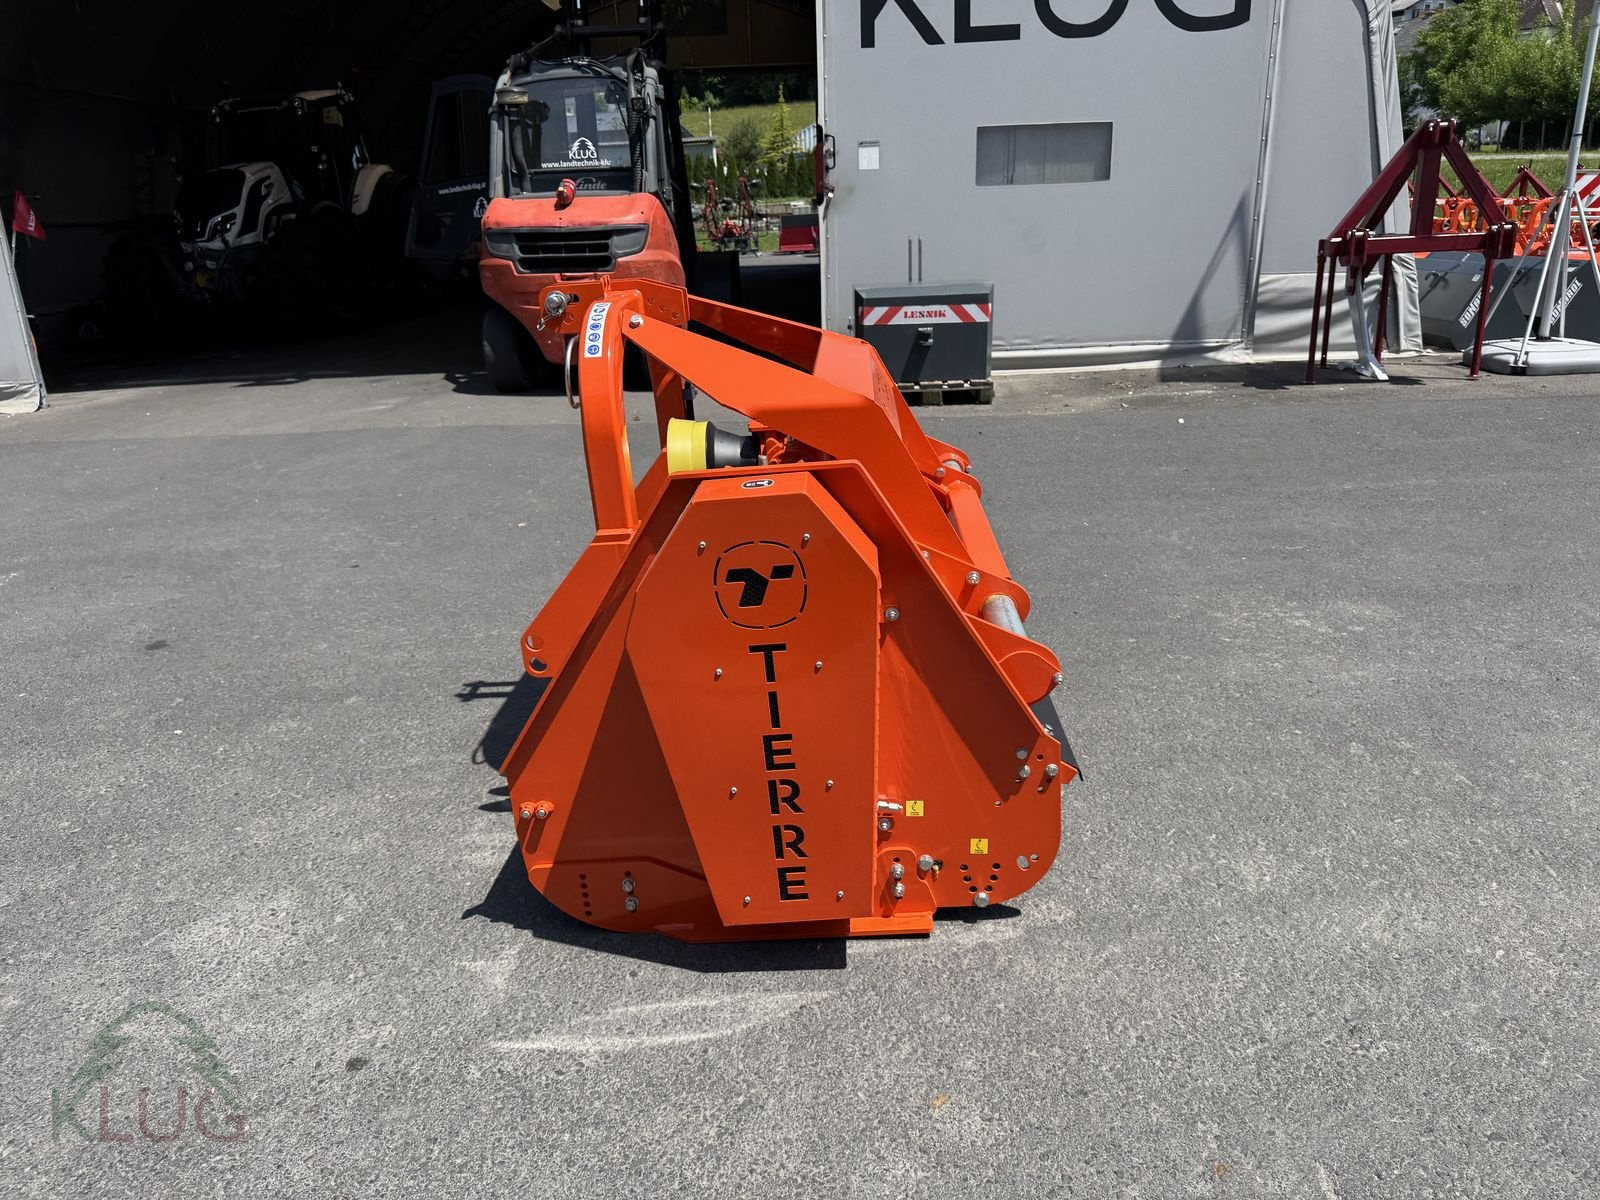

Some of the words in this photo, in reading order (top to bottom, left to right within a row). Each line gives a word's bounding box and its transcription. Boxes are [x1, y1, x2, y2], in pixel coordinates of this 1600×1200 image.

[568, 150, 597, 159] KLUG
[903, 310, 947, 319] LESNIK
[748, 643, 808, 902] TIERRE
